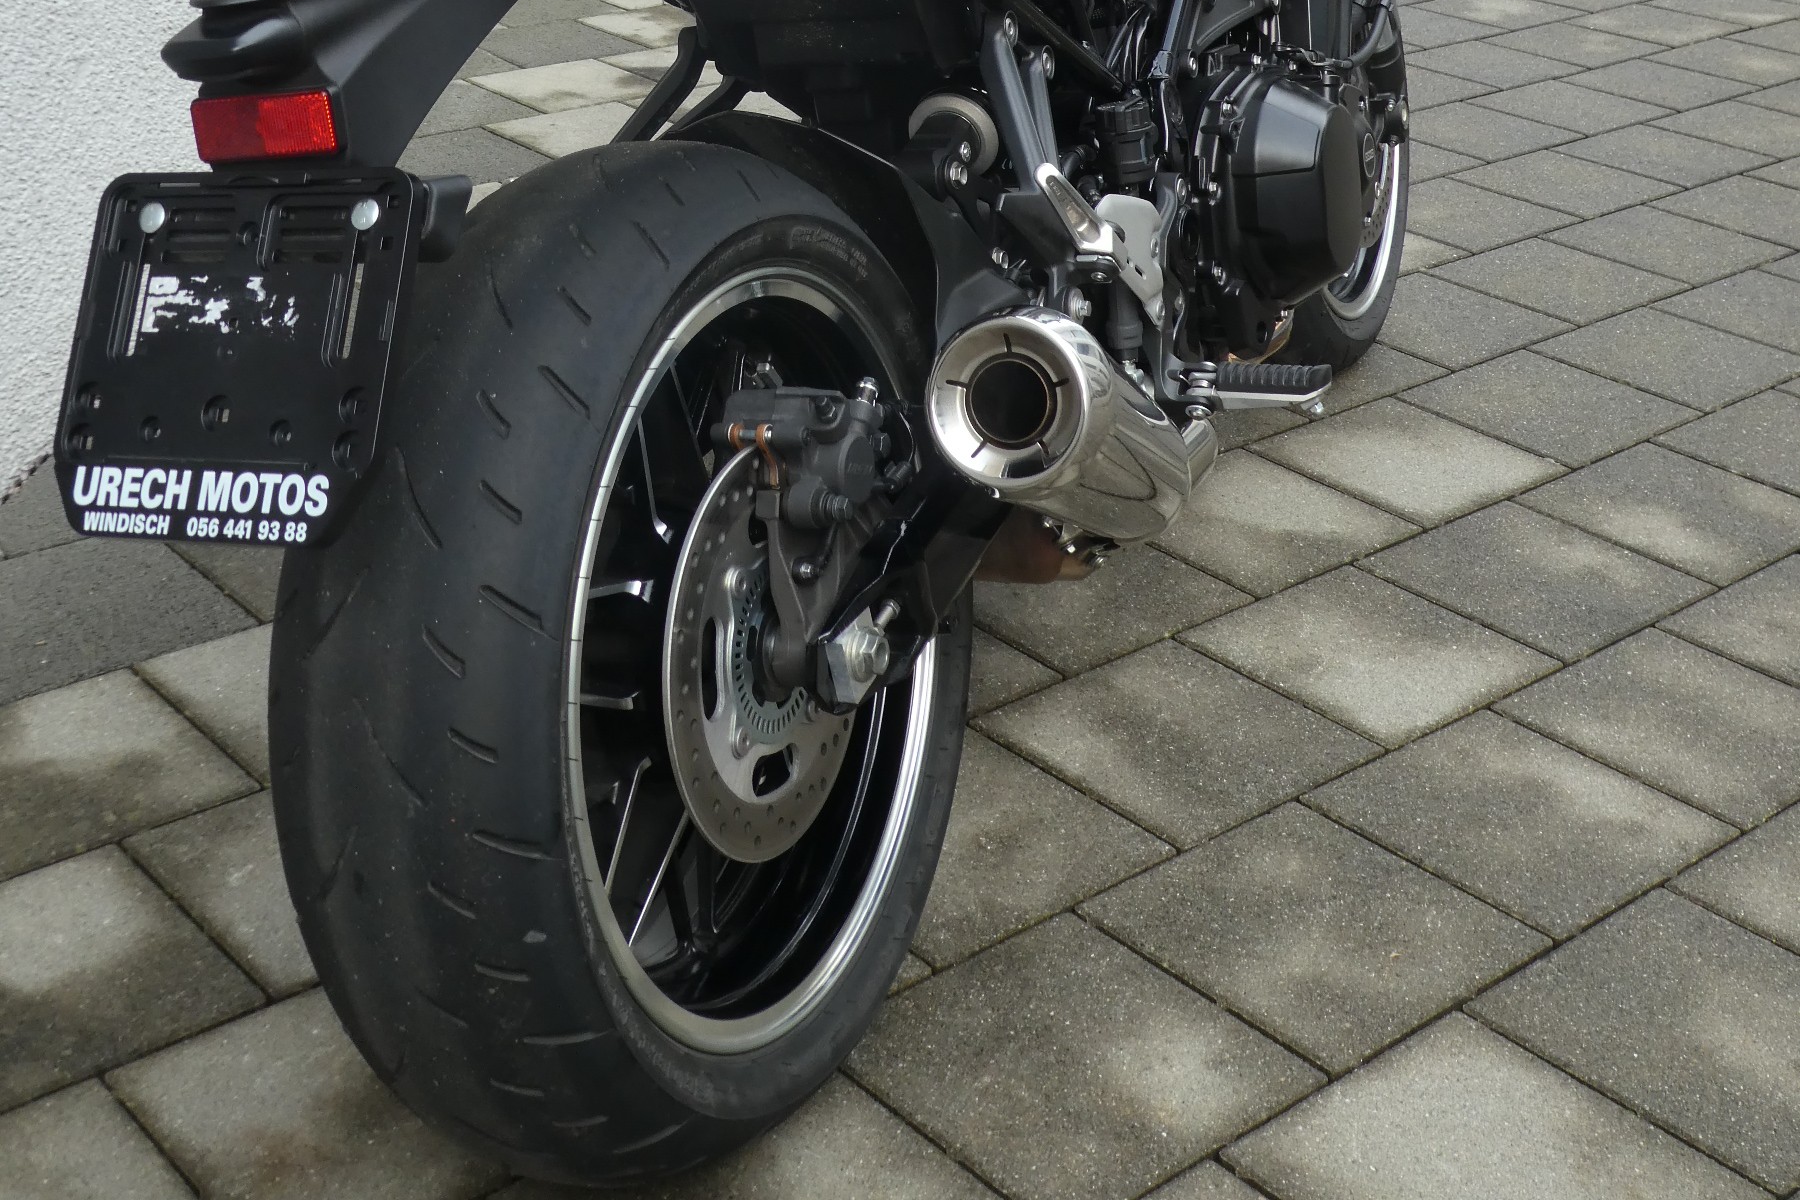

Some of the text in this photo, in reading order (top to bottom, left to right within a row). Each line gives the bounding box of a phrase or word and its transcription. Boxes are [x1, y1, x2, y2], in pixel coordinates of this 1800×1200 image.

[73, 465, 330, 517] URECH MOTOS
[83, 511, 308, 543] WINDISCH 056 441 93 88
